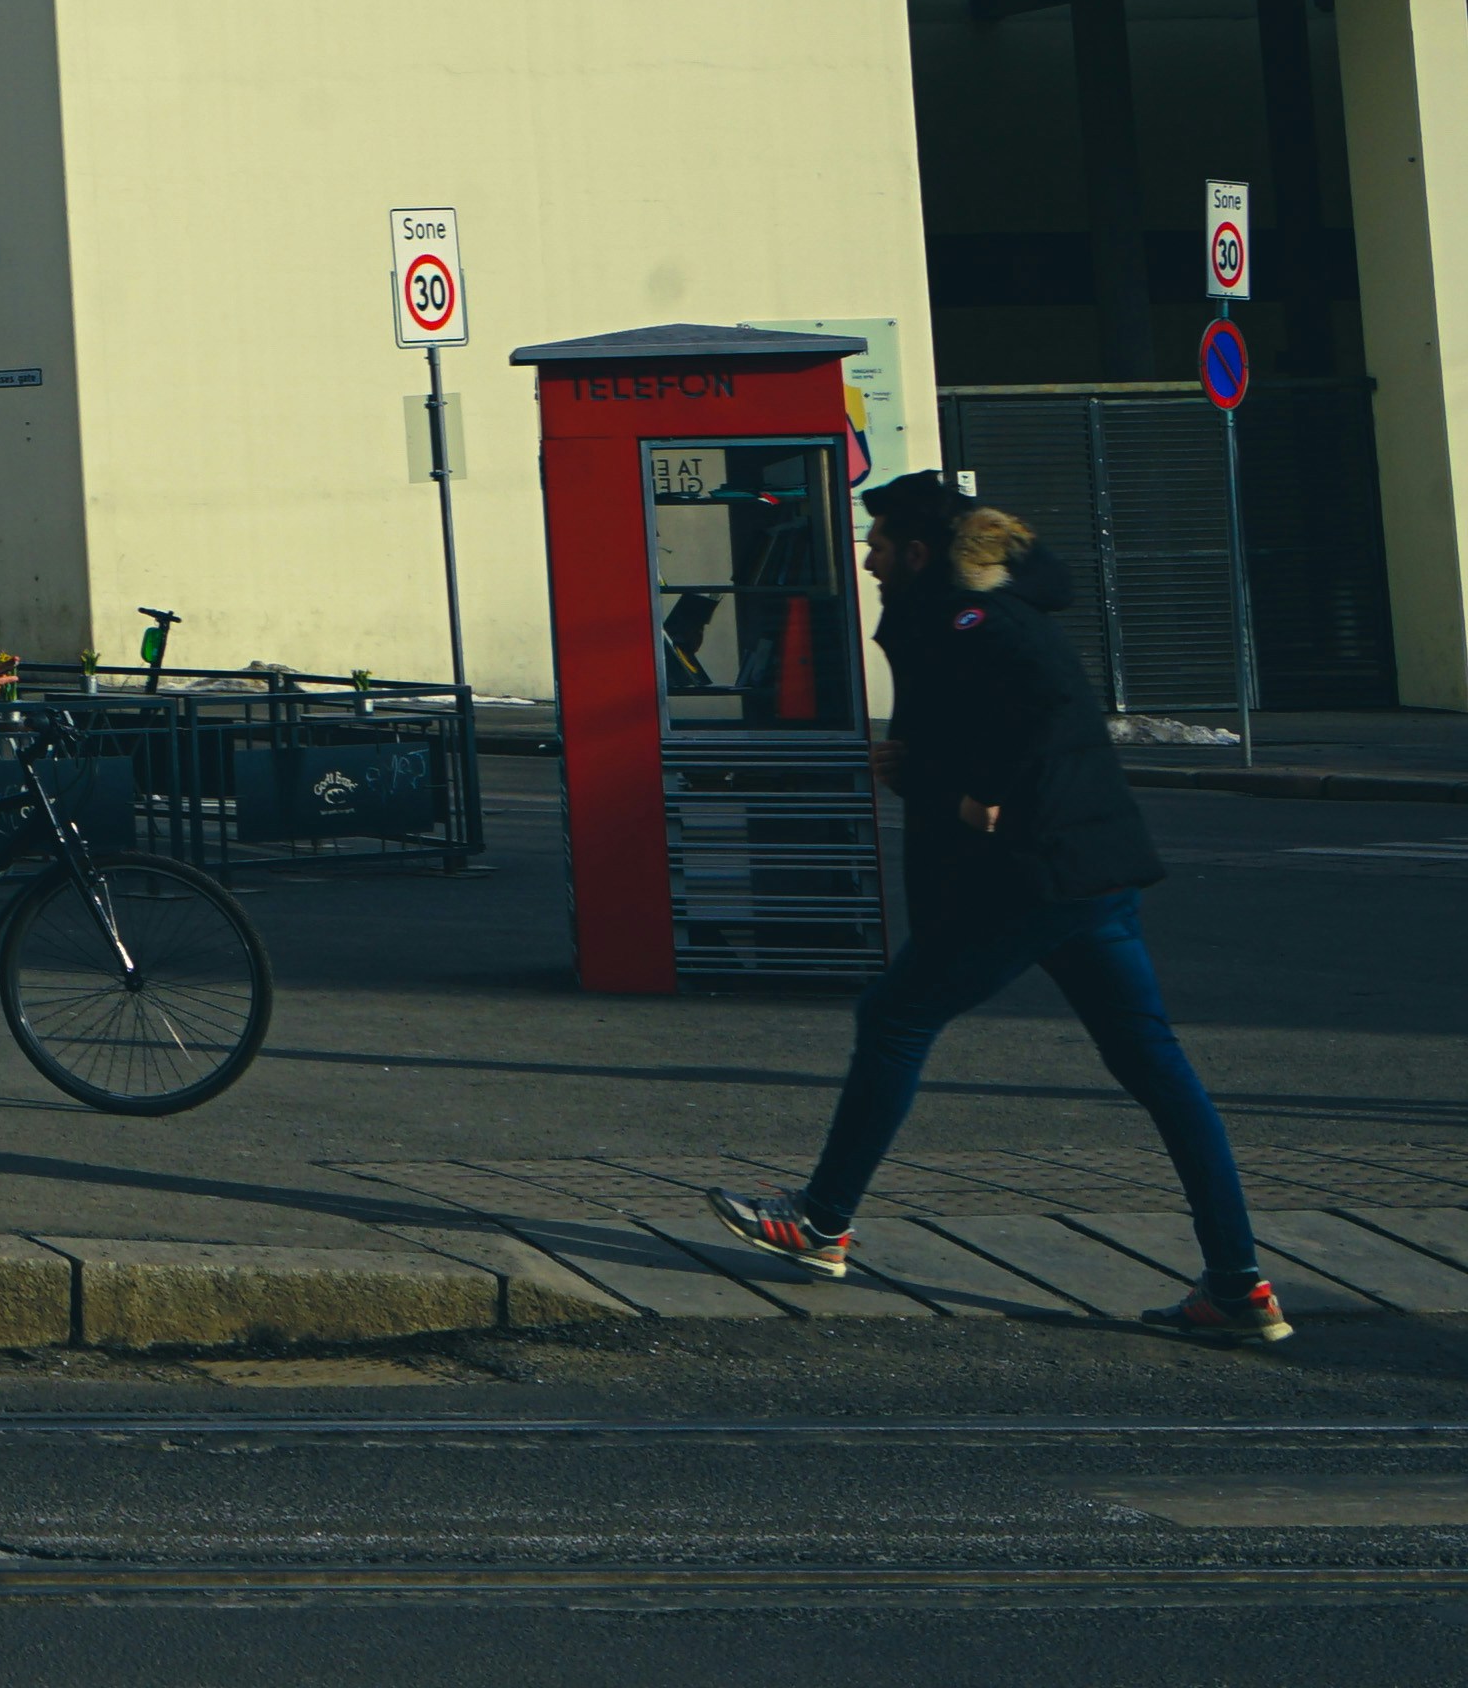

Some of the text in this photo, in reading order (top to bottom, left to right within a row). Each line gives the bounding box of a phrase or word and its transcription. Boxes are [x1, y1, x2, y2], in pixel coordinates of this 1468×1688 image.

[1213, 189, 1242, 211] Sone
[402, 217, 447, 241] Sone
[1218, 238, 1239, 271] 30
[413, 274, 446, 312] 30
[571, 371, 735, 402] TELEFON
